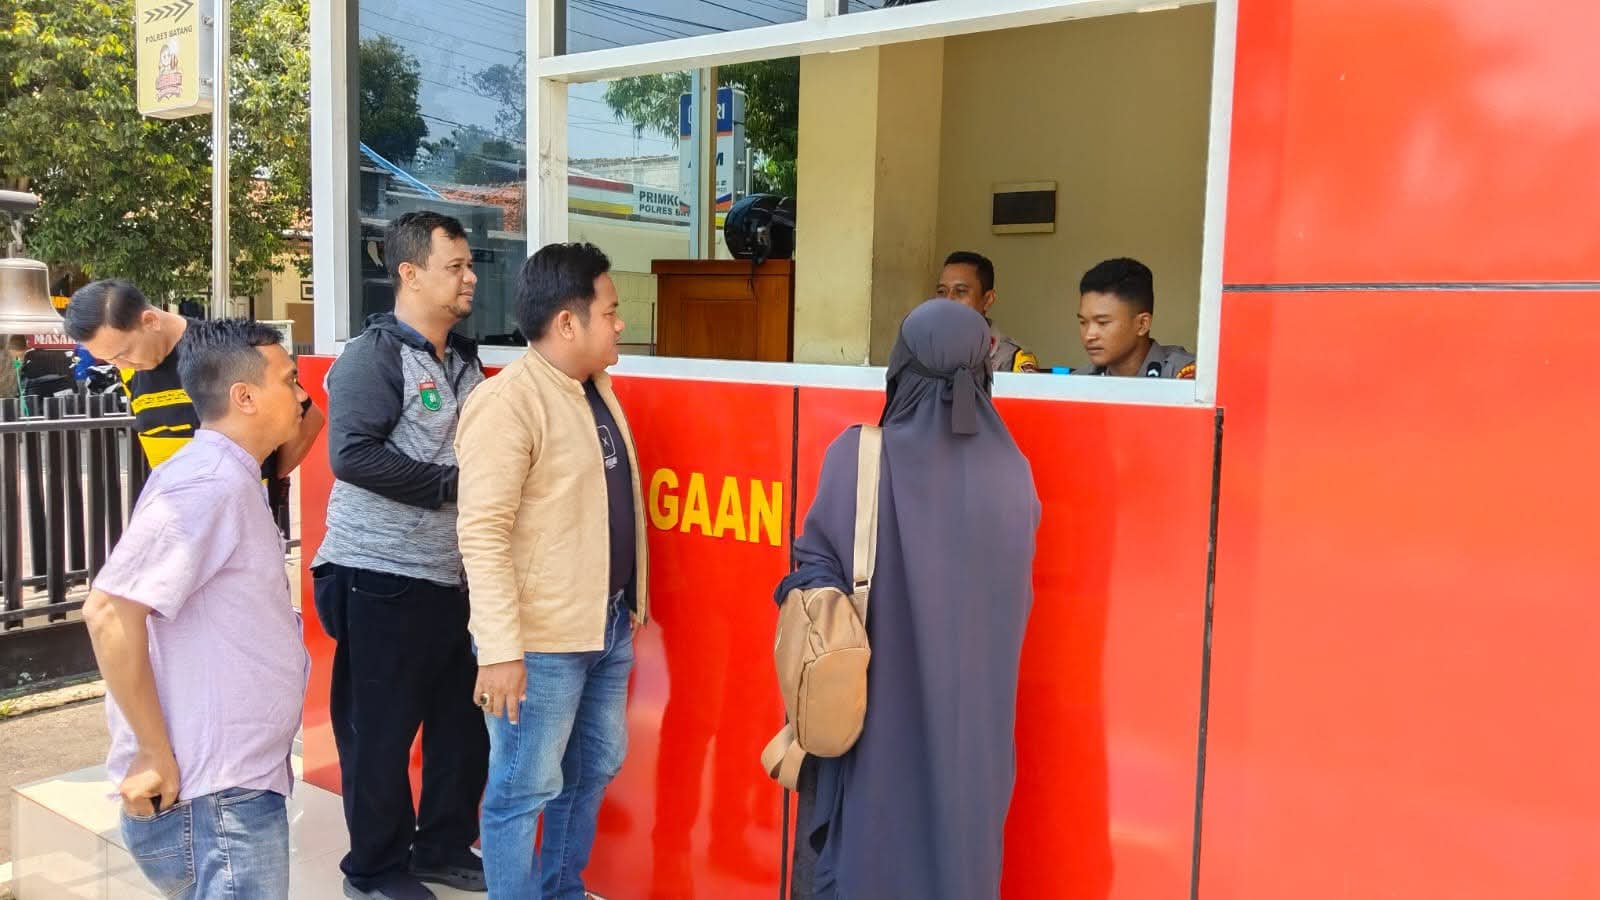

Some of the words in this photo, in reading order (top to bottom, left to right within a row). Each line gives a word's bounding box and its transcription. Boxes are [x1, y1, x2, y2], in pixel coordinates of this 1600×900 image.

[145, 32, 168, 43] POLRES
[169, 25, 193, 37] BATANG
[639, 204, 673, 215] POLRES
[649, 467, 783, 547] GAAN
